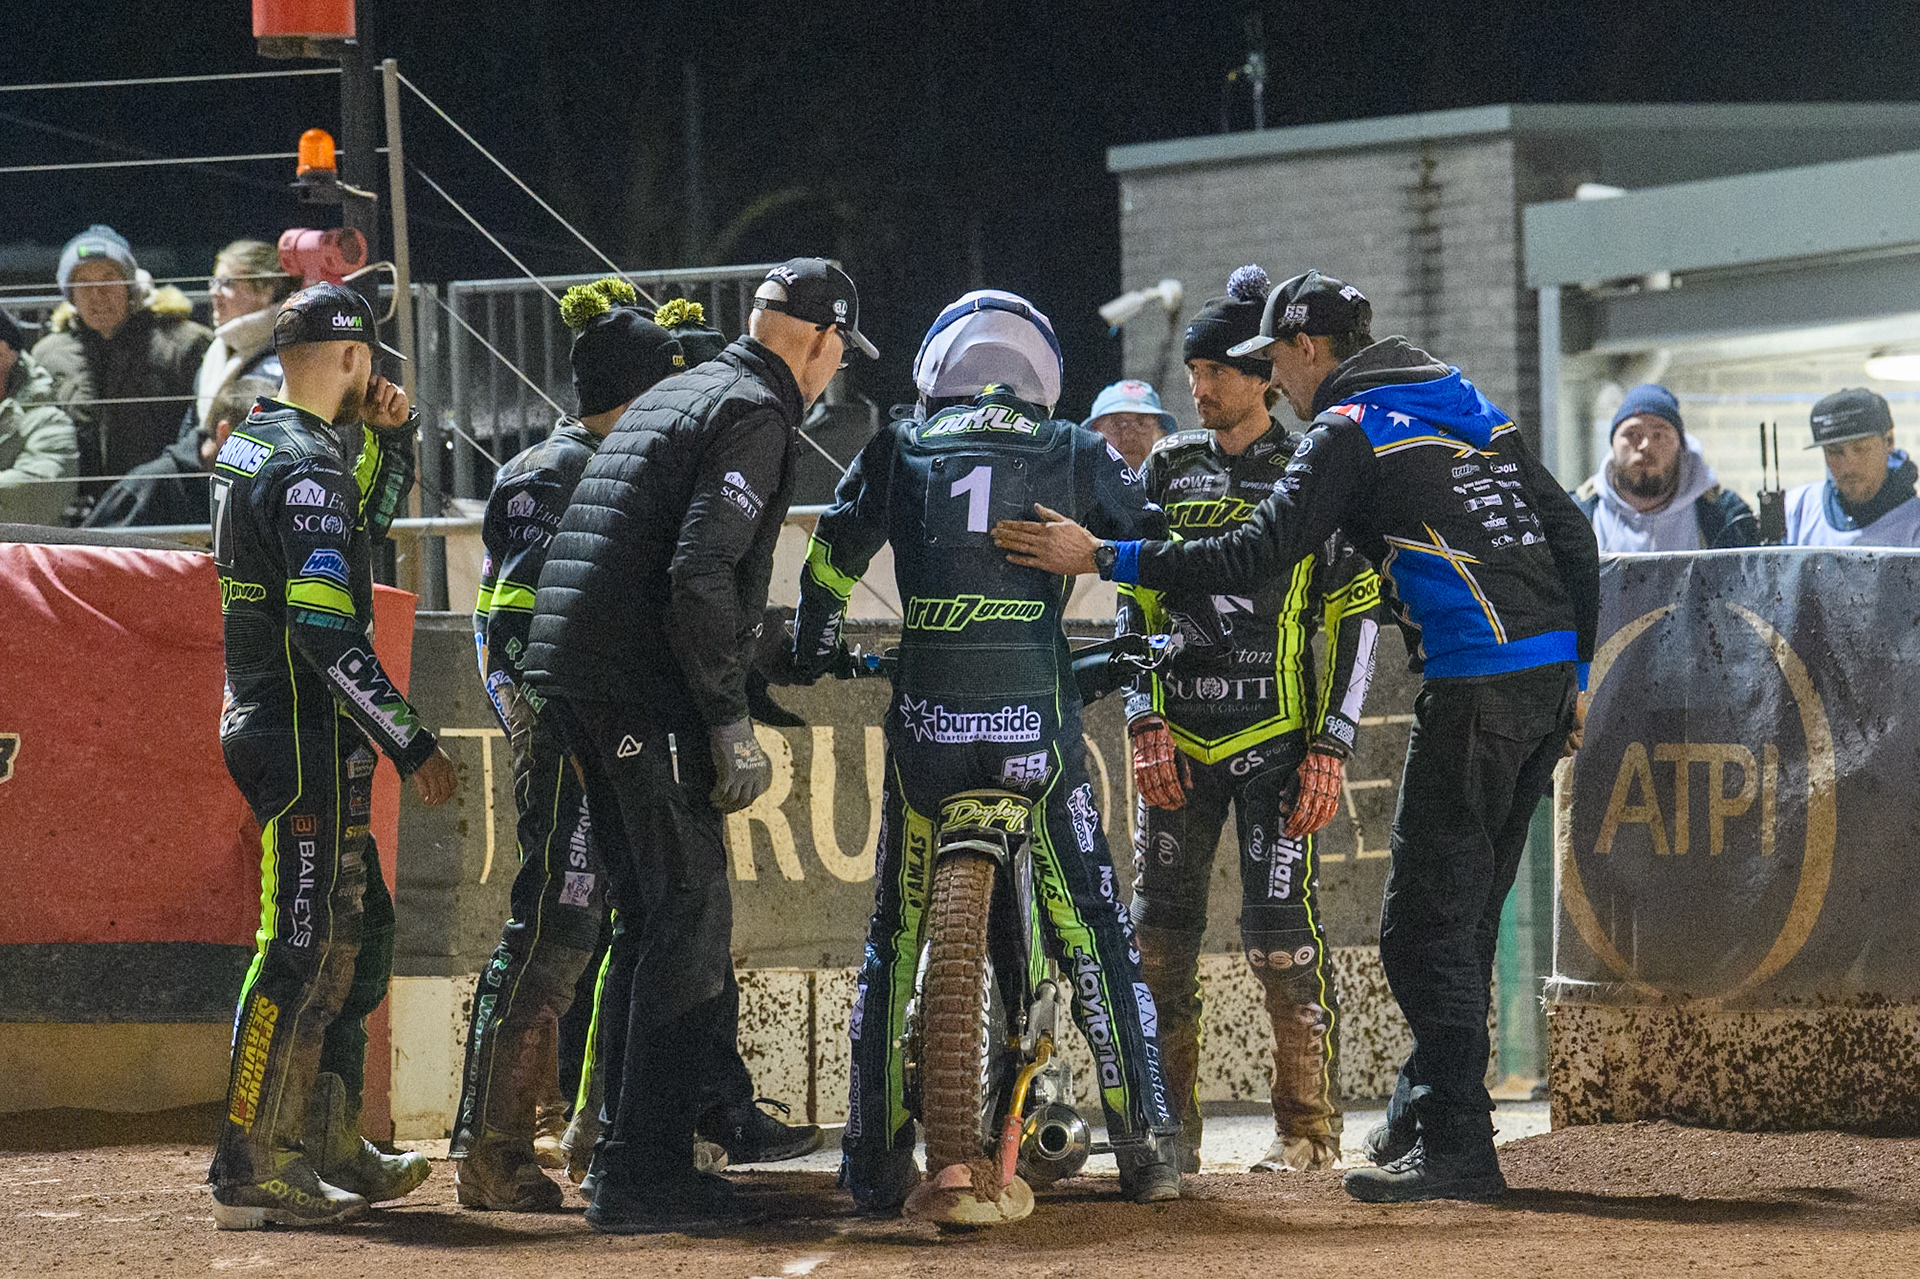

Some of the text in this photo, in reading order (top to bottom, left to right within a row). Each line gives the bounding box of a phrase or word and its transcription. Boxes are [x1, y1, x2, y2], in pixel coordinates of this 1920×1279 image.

[933, 406, 1035, 436] DOYLE
[288, 488, 322, 504] R.N.
[950, 466, 992, 533] 1
[1169, 475, 1214, 491] ROWE
[328, 666, 371, 711] MECHANICAL
[936, 705, 1040, 733] burnside
[981, 731, 1039, 741] accountants
[1003, 752, 1048, 780] 69
[941, 798, 1029, 832] Doyley
[1594, 742, 1779, 857] ATPI
[294, 841, 315, 949] BAILEYS
[1077, 954, 1122, 1088] daytona
[1135, 985, 1170, 1120] R.N. Euston
